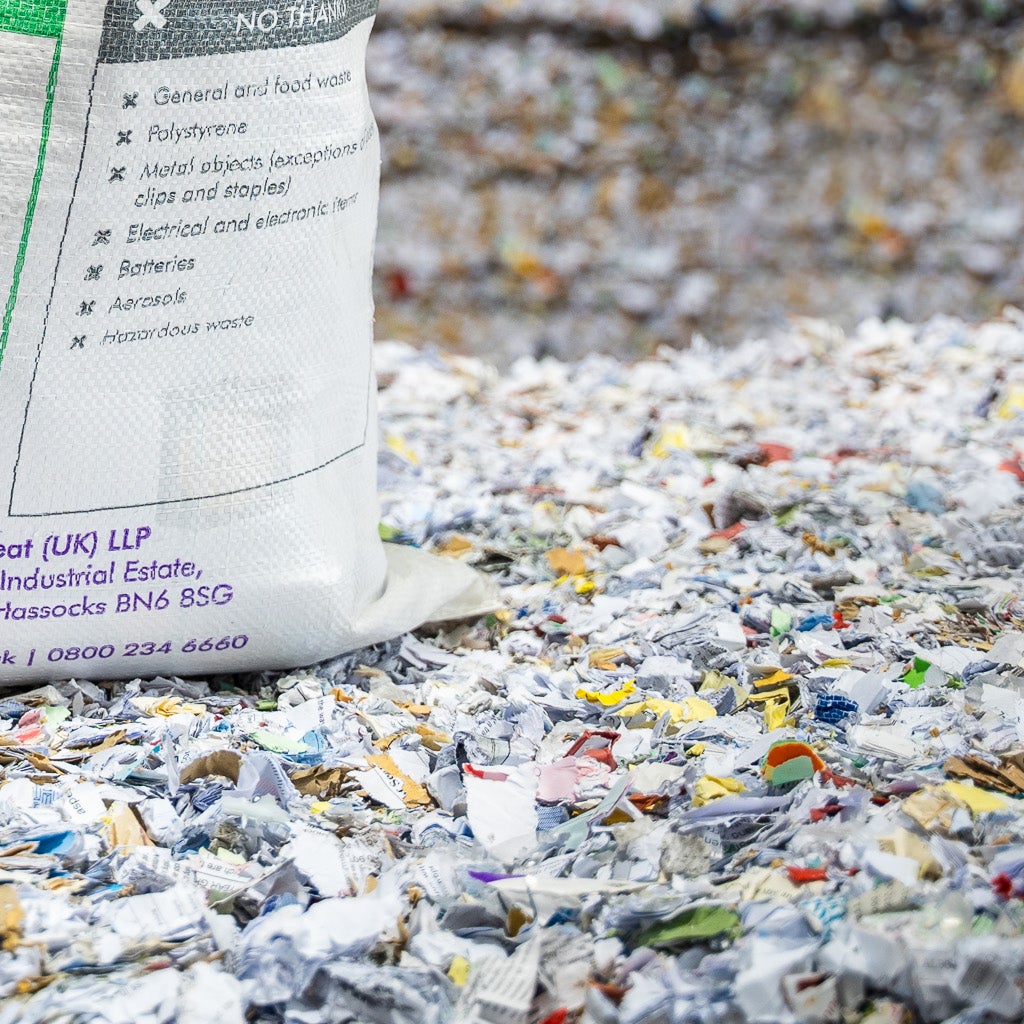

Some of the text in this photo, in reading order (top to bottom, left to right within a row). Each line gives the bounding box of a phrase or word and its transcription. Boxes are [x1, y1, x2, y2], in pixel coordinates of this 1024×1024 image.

[236, 7, 279, 35] NO
[154, 69, 352, 106] General and food waste
[147, 122, 248, 146] Polystyrene
[139, 141, 358, 181] Metal objects (exceptions
[134, 175, 292, 210] clips and staples)
[126, 216, 209, 245] Electrical
[214, 213, 250, 234] and
[255, 200, 329, 230] electronic
[118, 255, 196, 280] Batteries
[108, 287, 188, 314] Aerosols
[99, 313, 255, 346] Hazardous waste
[42, 530, 98, 562] (UK)
[108, 526, 152, 552] LLP
[0, 561, 115, 591] Industrial
[124, 558, 203, 583] Estate,
[115, 588, 170, 614] BN6
[180, 584, 234, 609] 8SG
[47, 644, 115, 662] 0800
[122, 640, 172, 657] 234
[181, 634, 249, 654] 6660
